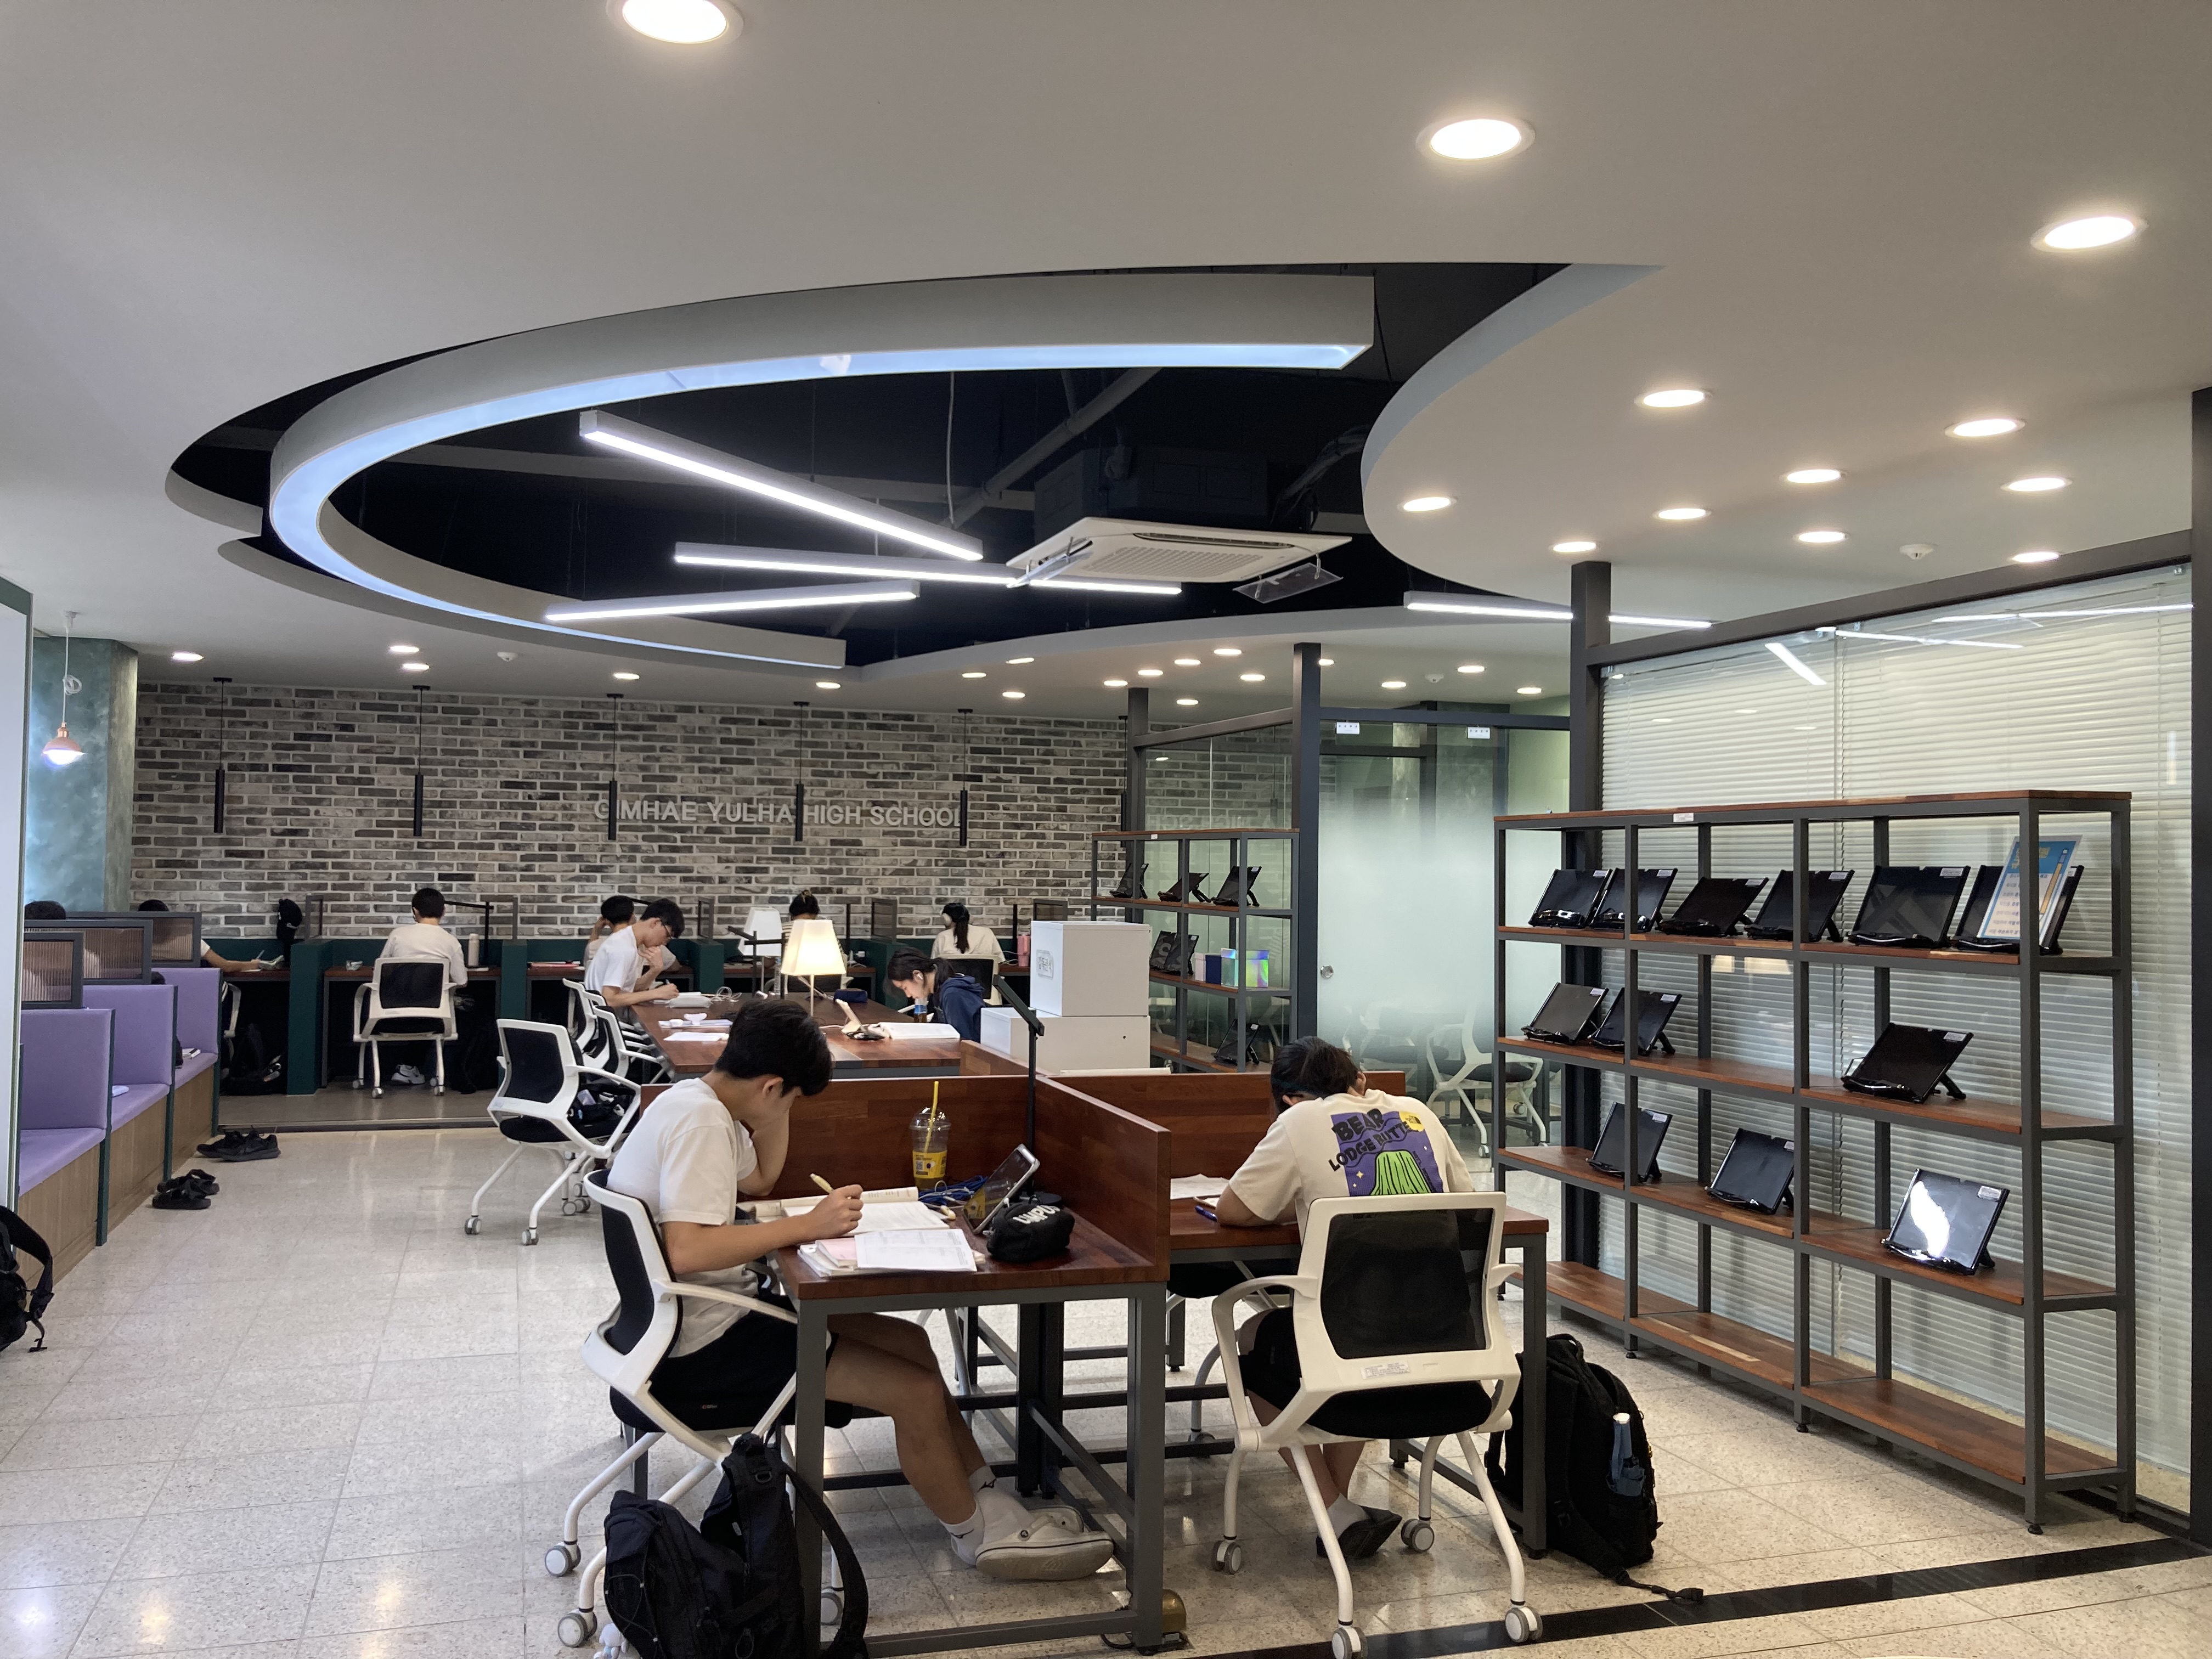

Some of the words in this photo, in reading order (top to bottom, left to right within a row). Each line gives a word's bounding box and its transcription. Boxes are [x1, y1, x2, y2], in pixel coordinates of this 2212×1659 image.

[707, 801, 794, 823] YULHA
[803, 804, 861, 825] HIGH
[1331, 1108, 1384, 1142] BEAR
[1328, 1138, 1376, 1172] LODGE
